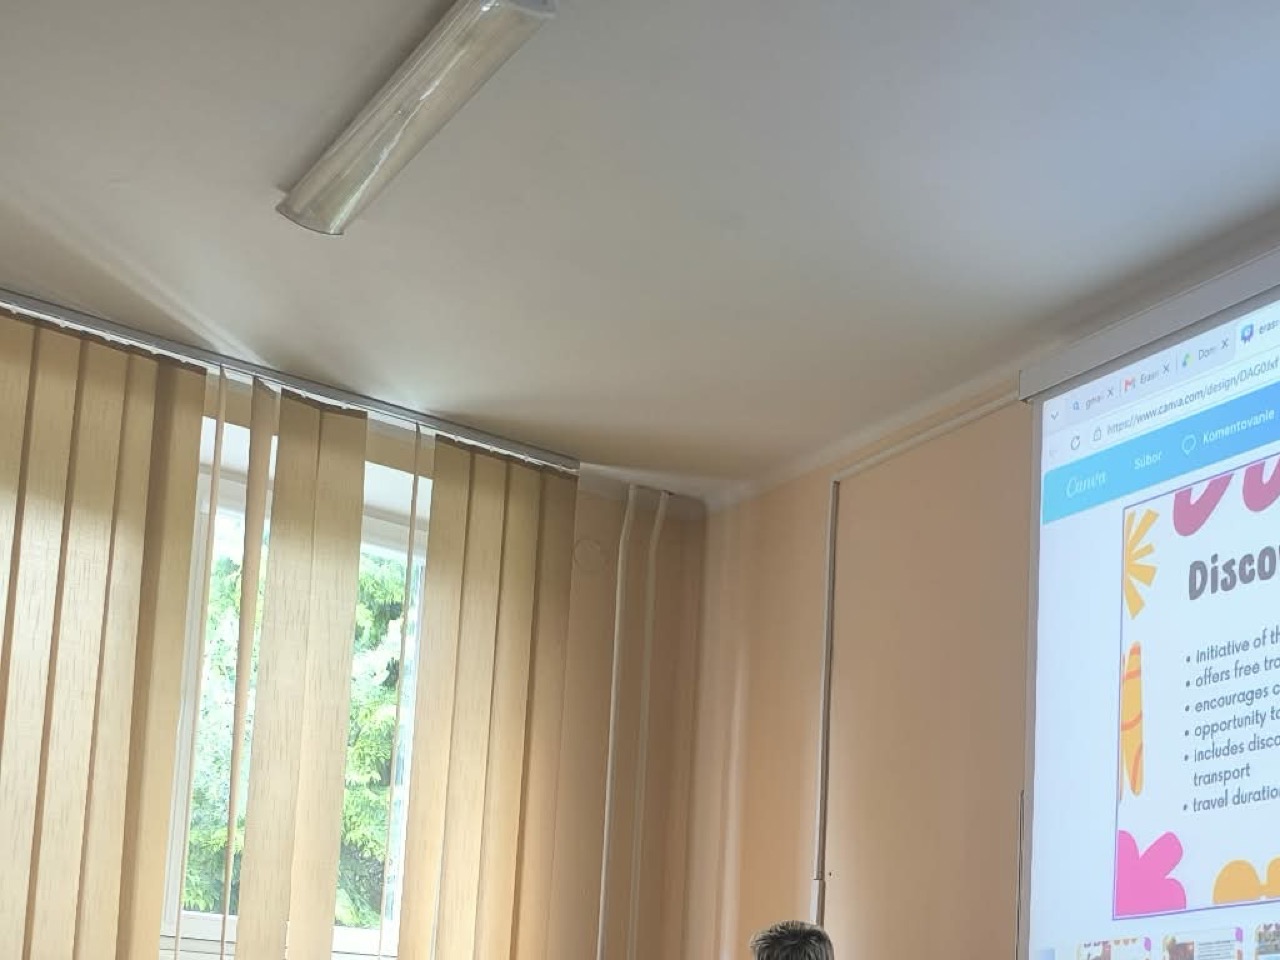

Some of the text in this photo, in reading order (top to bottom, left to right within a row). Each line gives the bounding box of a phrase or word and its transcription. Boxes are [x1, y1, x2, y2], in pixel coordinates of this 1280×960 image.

[1203, 408, 1275, 446] Komentovanie
[1066, 468, 1107, 498] Canva
[1254, 629, 1268, 648] of
[1195, 669, 1231, 688] offers
[1235, 662, 1260, 680] free
[1194, 686, 1269, 713] encourages
[1194, 709, 1267, 741] opportunity
[1194, 739, 1244, 762] includes
[1193, 763, 1250, 787] transport
[1193, 789, 1229, 812] travel
